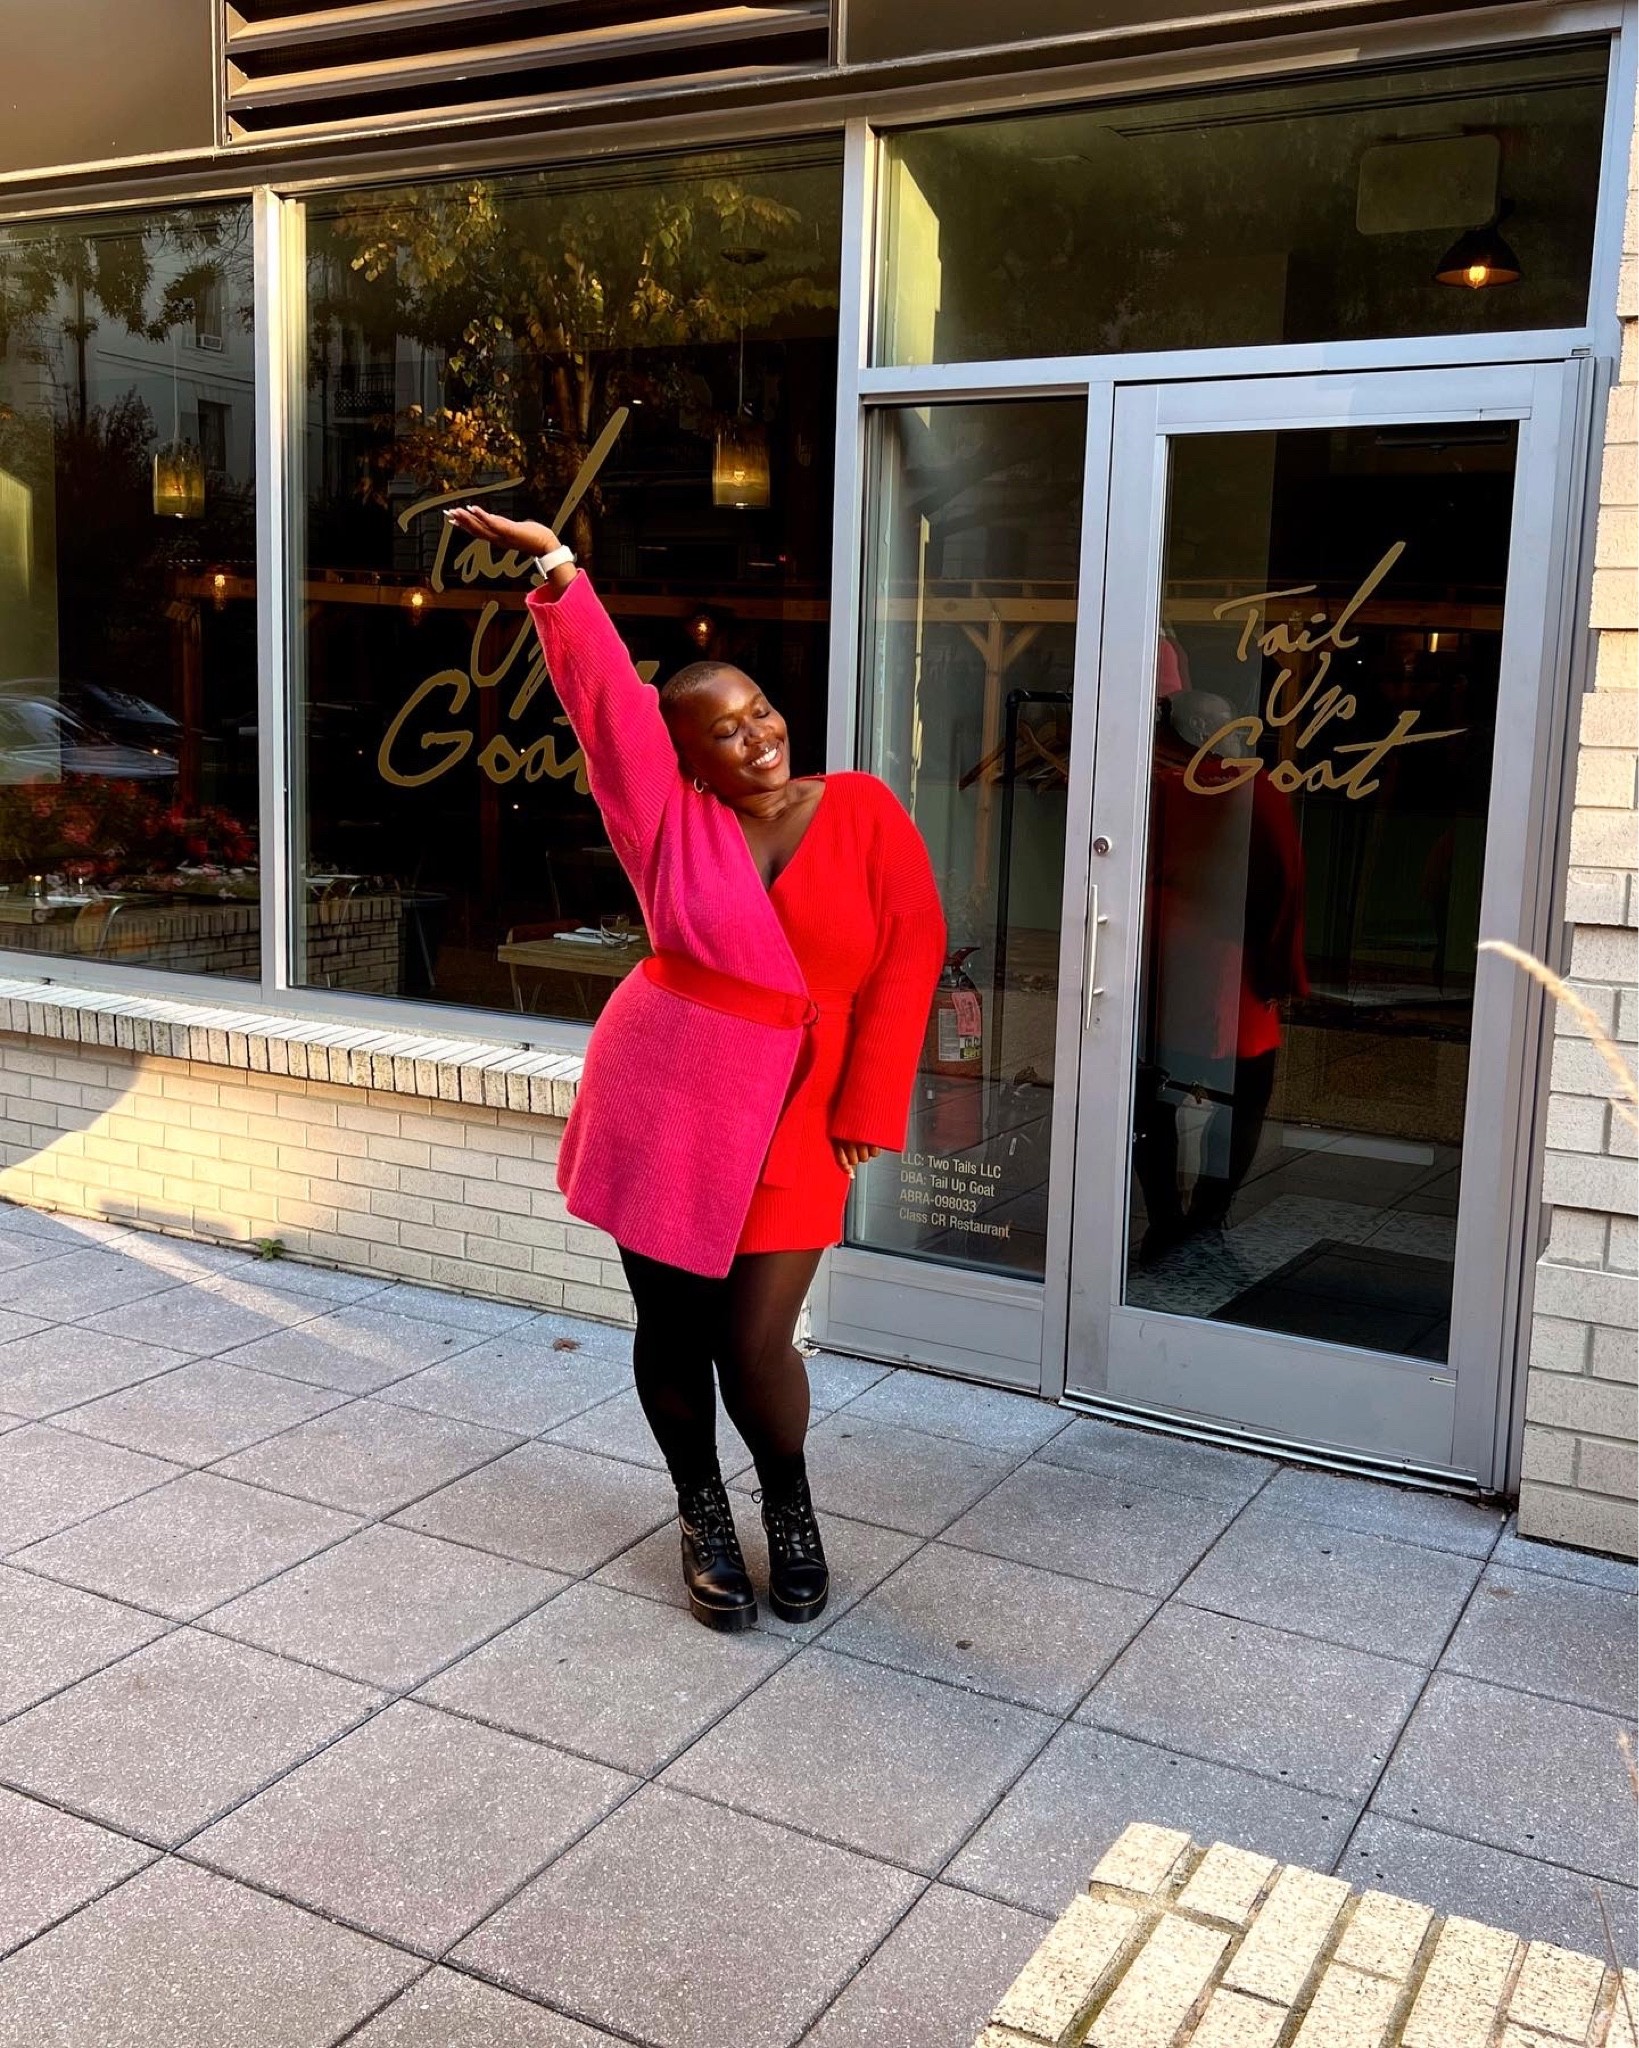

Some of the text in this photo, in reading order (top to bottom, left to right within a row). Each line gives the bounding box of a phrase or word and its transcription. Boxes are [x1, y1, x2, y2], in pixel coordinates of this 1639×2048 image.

[1213, 541, 1406, 662] Tail
[1266, 651, 1357, 749] Up
[1183, 710, 1468, 800] Goat
[901, 1152, 1002, 1179] LLC: Two Tails LLC
[900, 1170, 995, 1197] DBA: Tail Up Goat
[900, 1189, 977, 1213] ABRA-098033
[899, 1207, 1010, 1238] Class CR Restaurant
